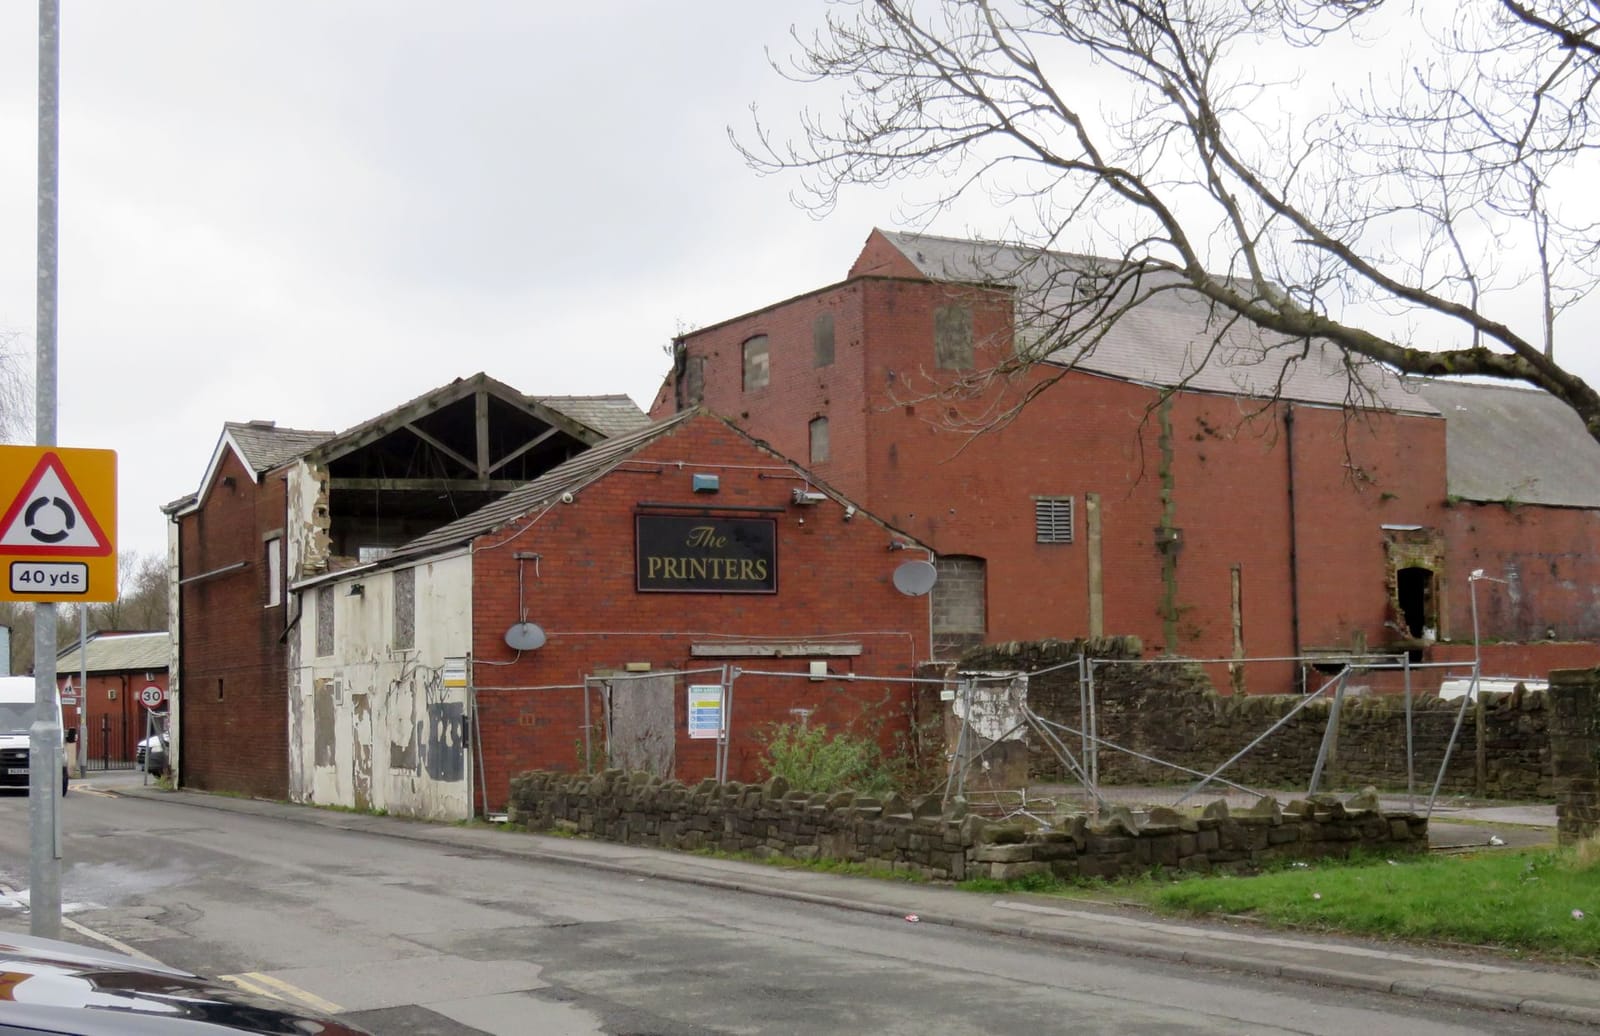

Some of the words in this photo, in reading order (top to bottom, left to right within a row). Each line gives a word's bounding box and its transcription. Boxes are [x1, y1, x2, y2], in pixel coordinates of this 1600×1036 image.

[686, 526, 727, 548] The
[648, 556, 767, 580] PRINTERS
[19, 570, 45, 583] 40
[50, 571, 79, 586] yds
[143, 691, 161, 701] 30
